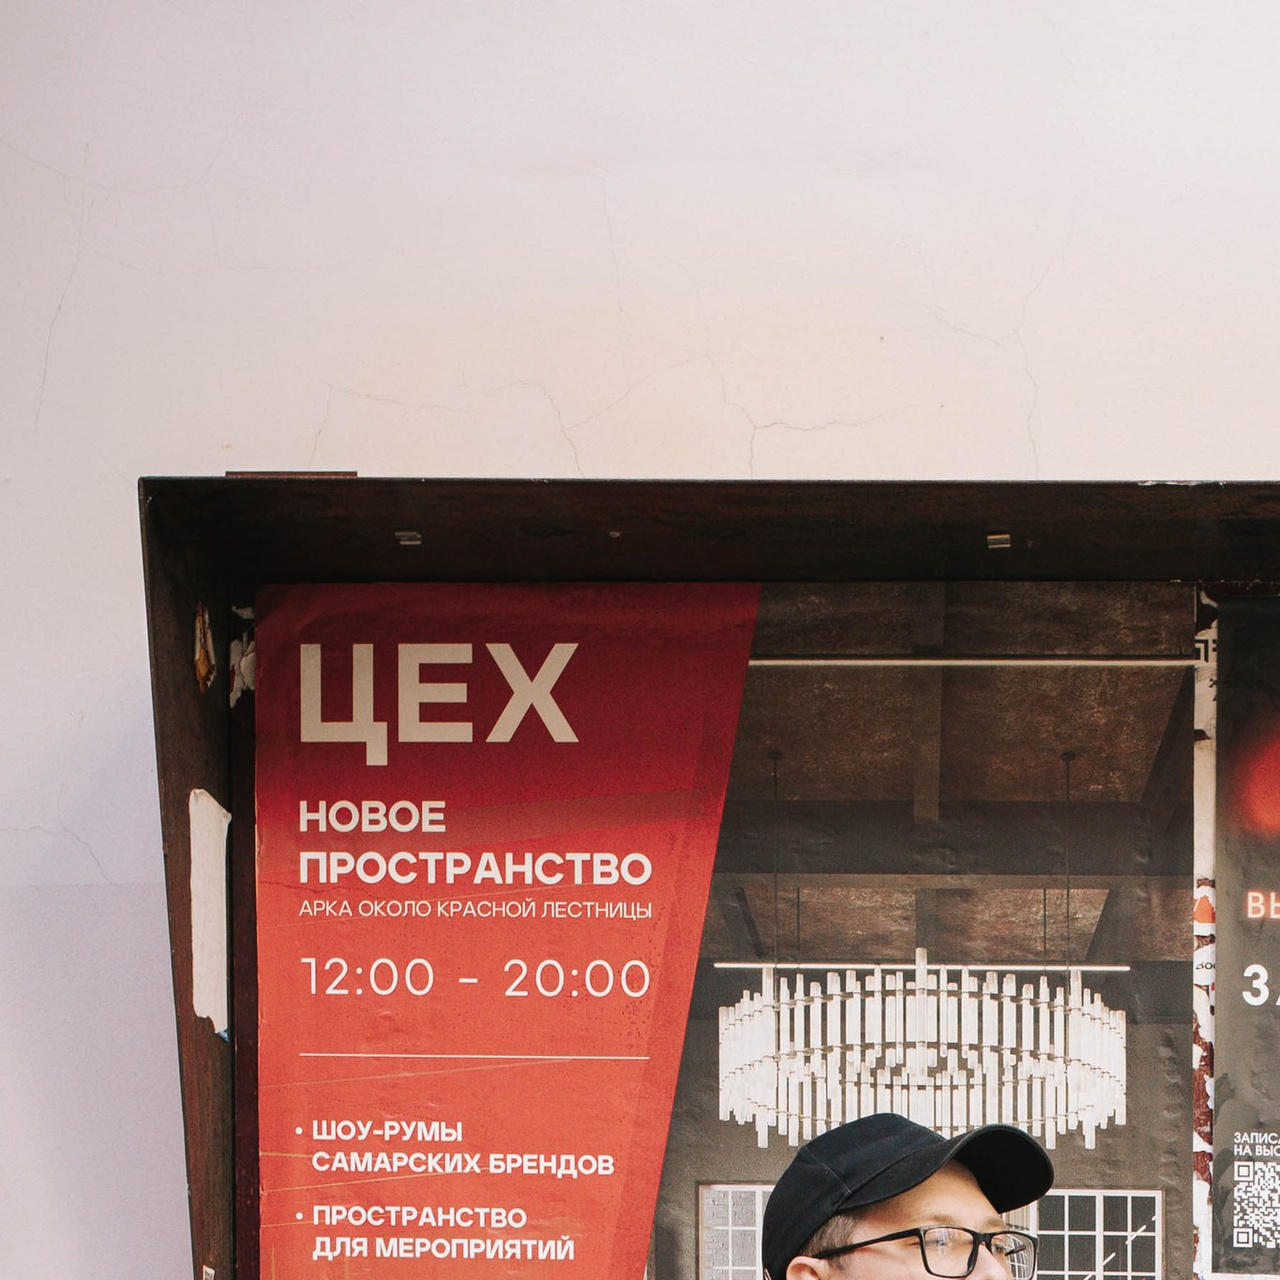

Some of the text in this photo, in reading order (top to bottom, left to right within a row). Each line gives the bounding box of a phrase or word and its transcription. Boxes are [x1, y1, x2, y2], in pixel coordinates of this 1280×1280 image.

[300, 643, 579, 766] ЦЕХ
[300, 800, 446, 832] НОВОЕ
[300, 851, 653, 884] ПРОСТРАНСТВО
[299, 897, 652, 921] АРКА ОКОЛО КРАСНОЙ ЛЕСТНИЦЫ
[301, 957, 434, 995] 12:00
[504, 959, 650, 997] 20:00
[312, 1120, 463, 1142] ШОУ-РУМЫ
[1234, 1145, 1252, 1156] НА
[311, 1151, 615, 1179] САМАРСКИХ БРЕНДОВ
[313, 1205, 527, 1228] ПРОСТРАНСТВО
[312, 1233, 575, 1261] ДЛЯ МЕРОПРИЯТИЙ
